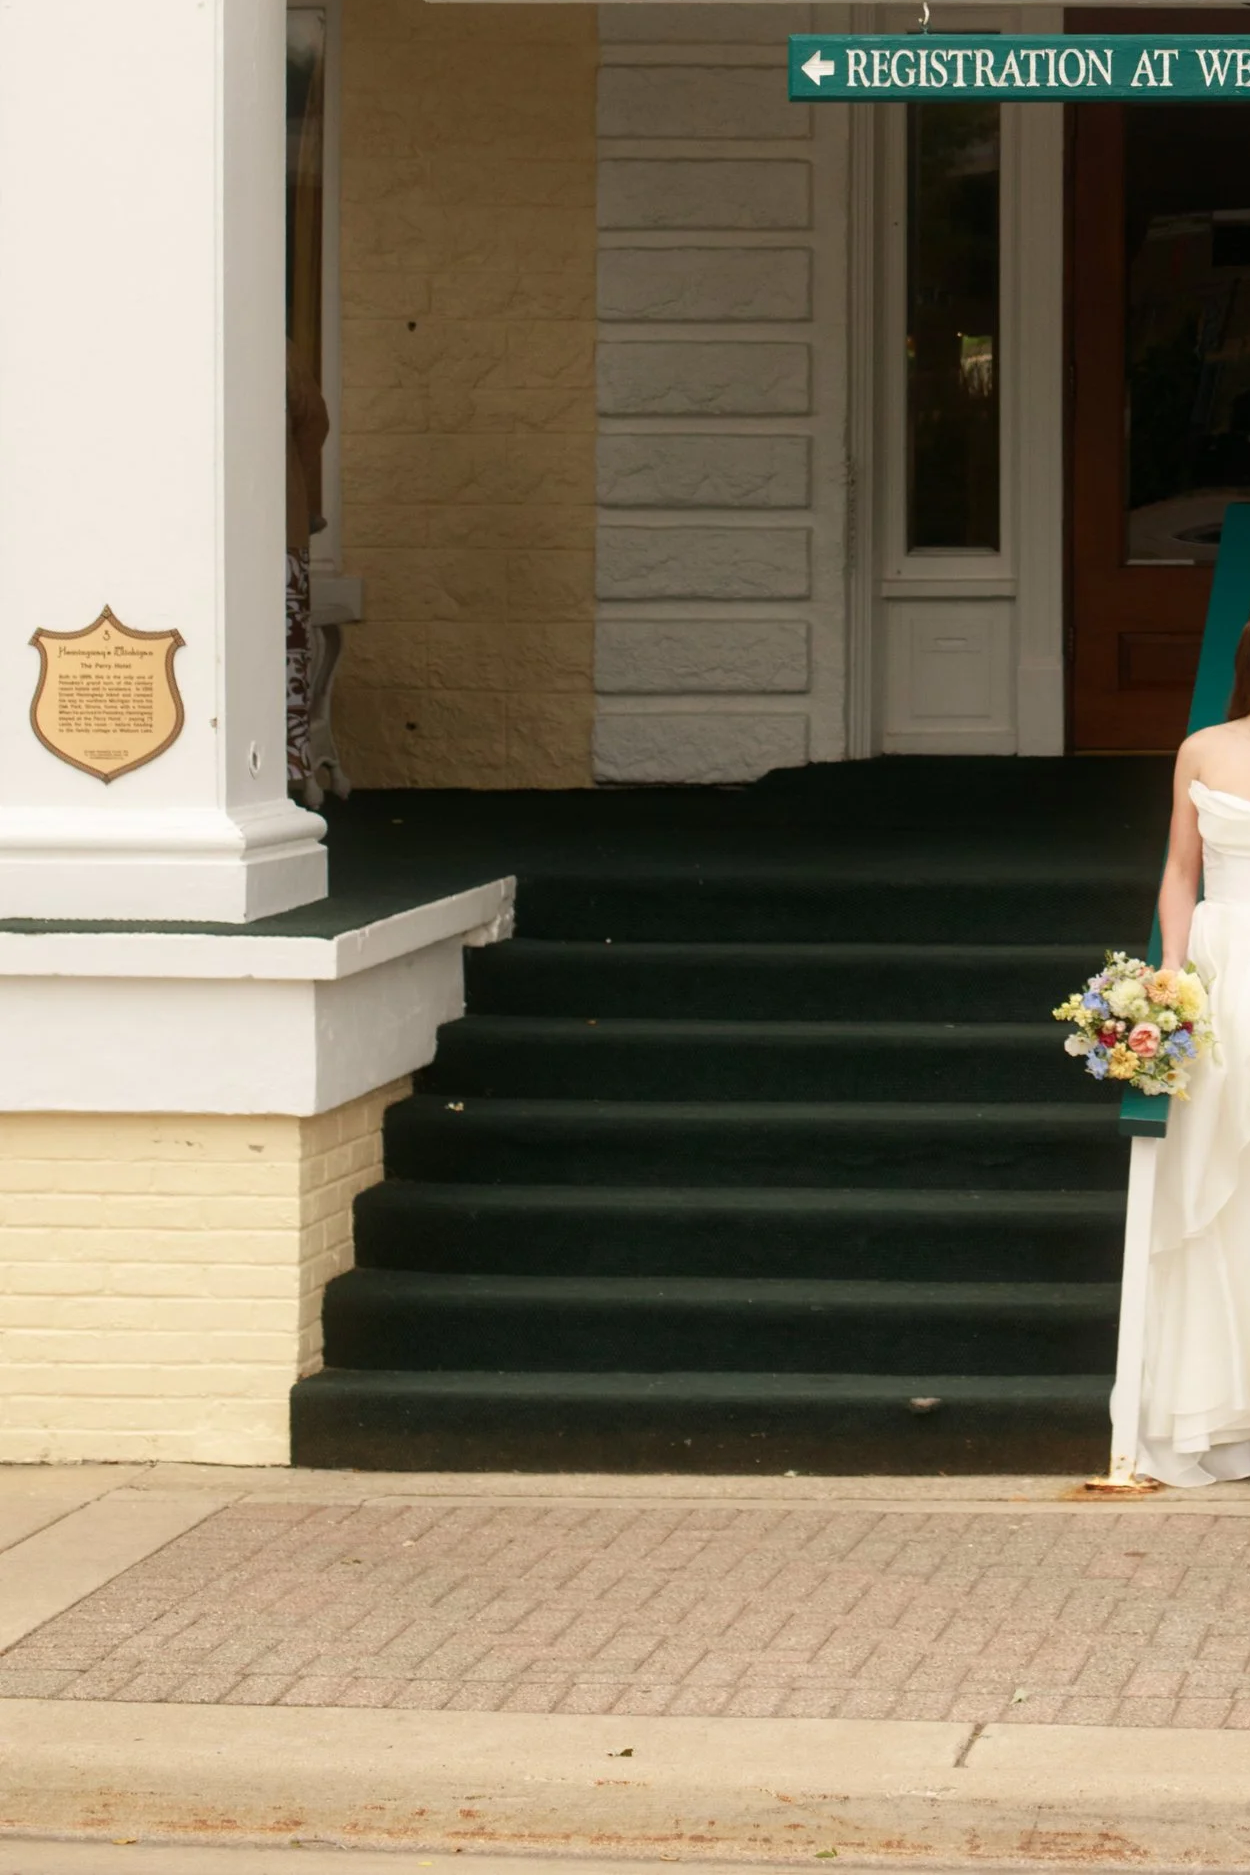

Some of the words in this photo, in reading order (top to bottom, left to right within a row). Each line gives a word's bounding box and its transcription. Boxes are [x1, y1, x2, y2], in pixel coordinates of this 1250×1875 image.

[846, 49, 1112, 87] REGISTRATION
[1131, 49, 1178, 87] AT
[95, 662, 111, 670] Perry
